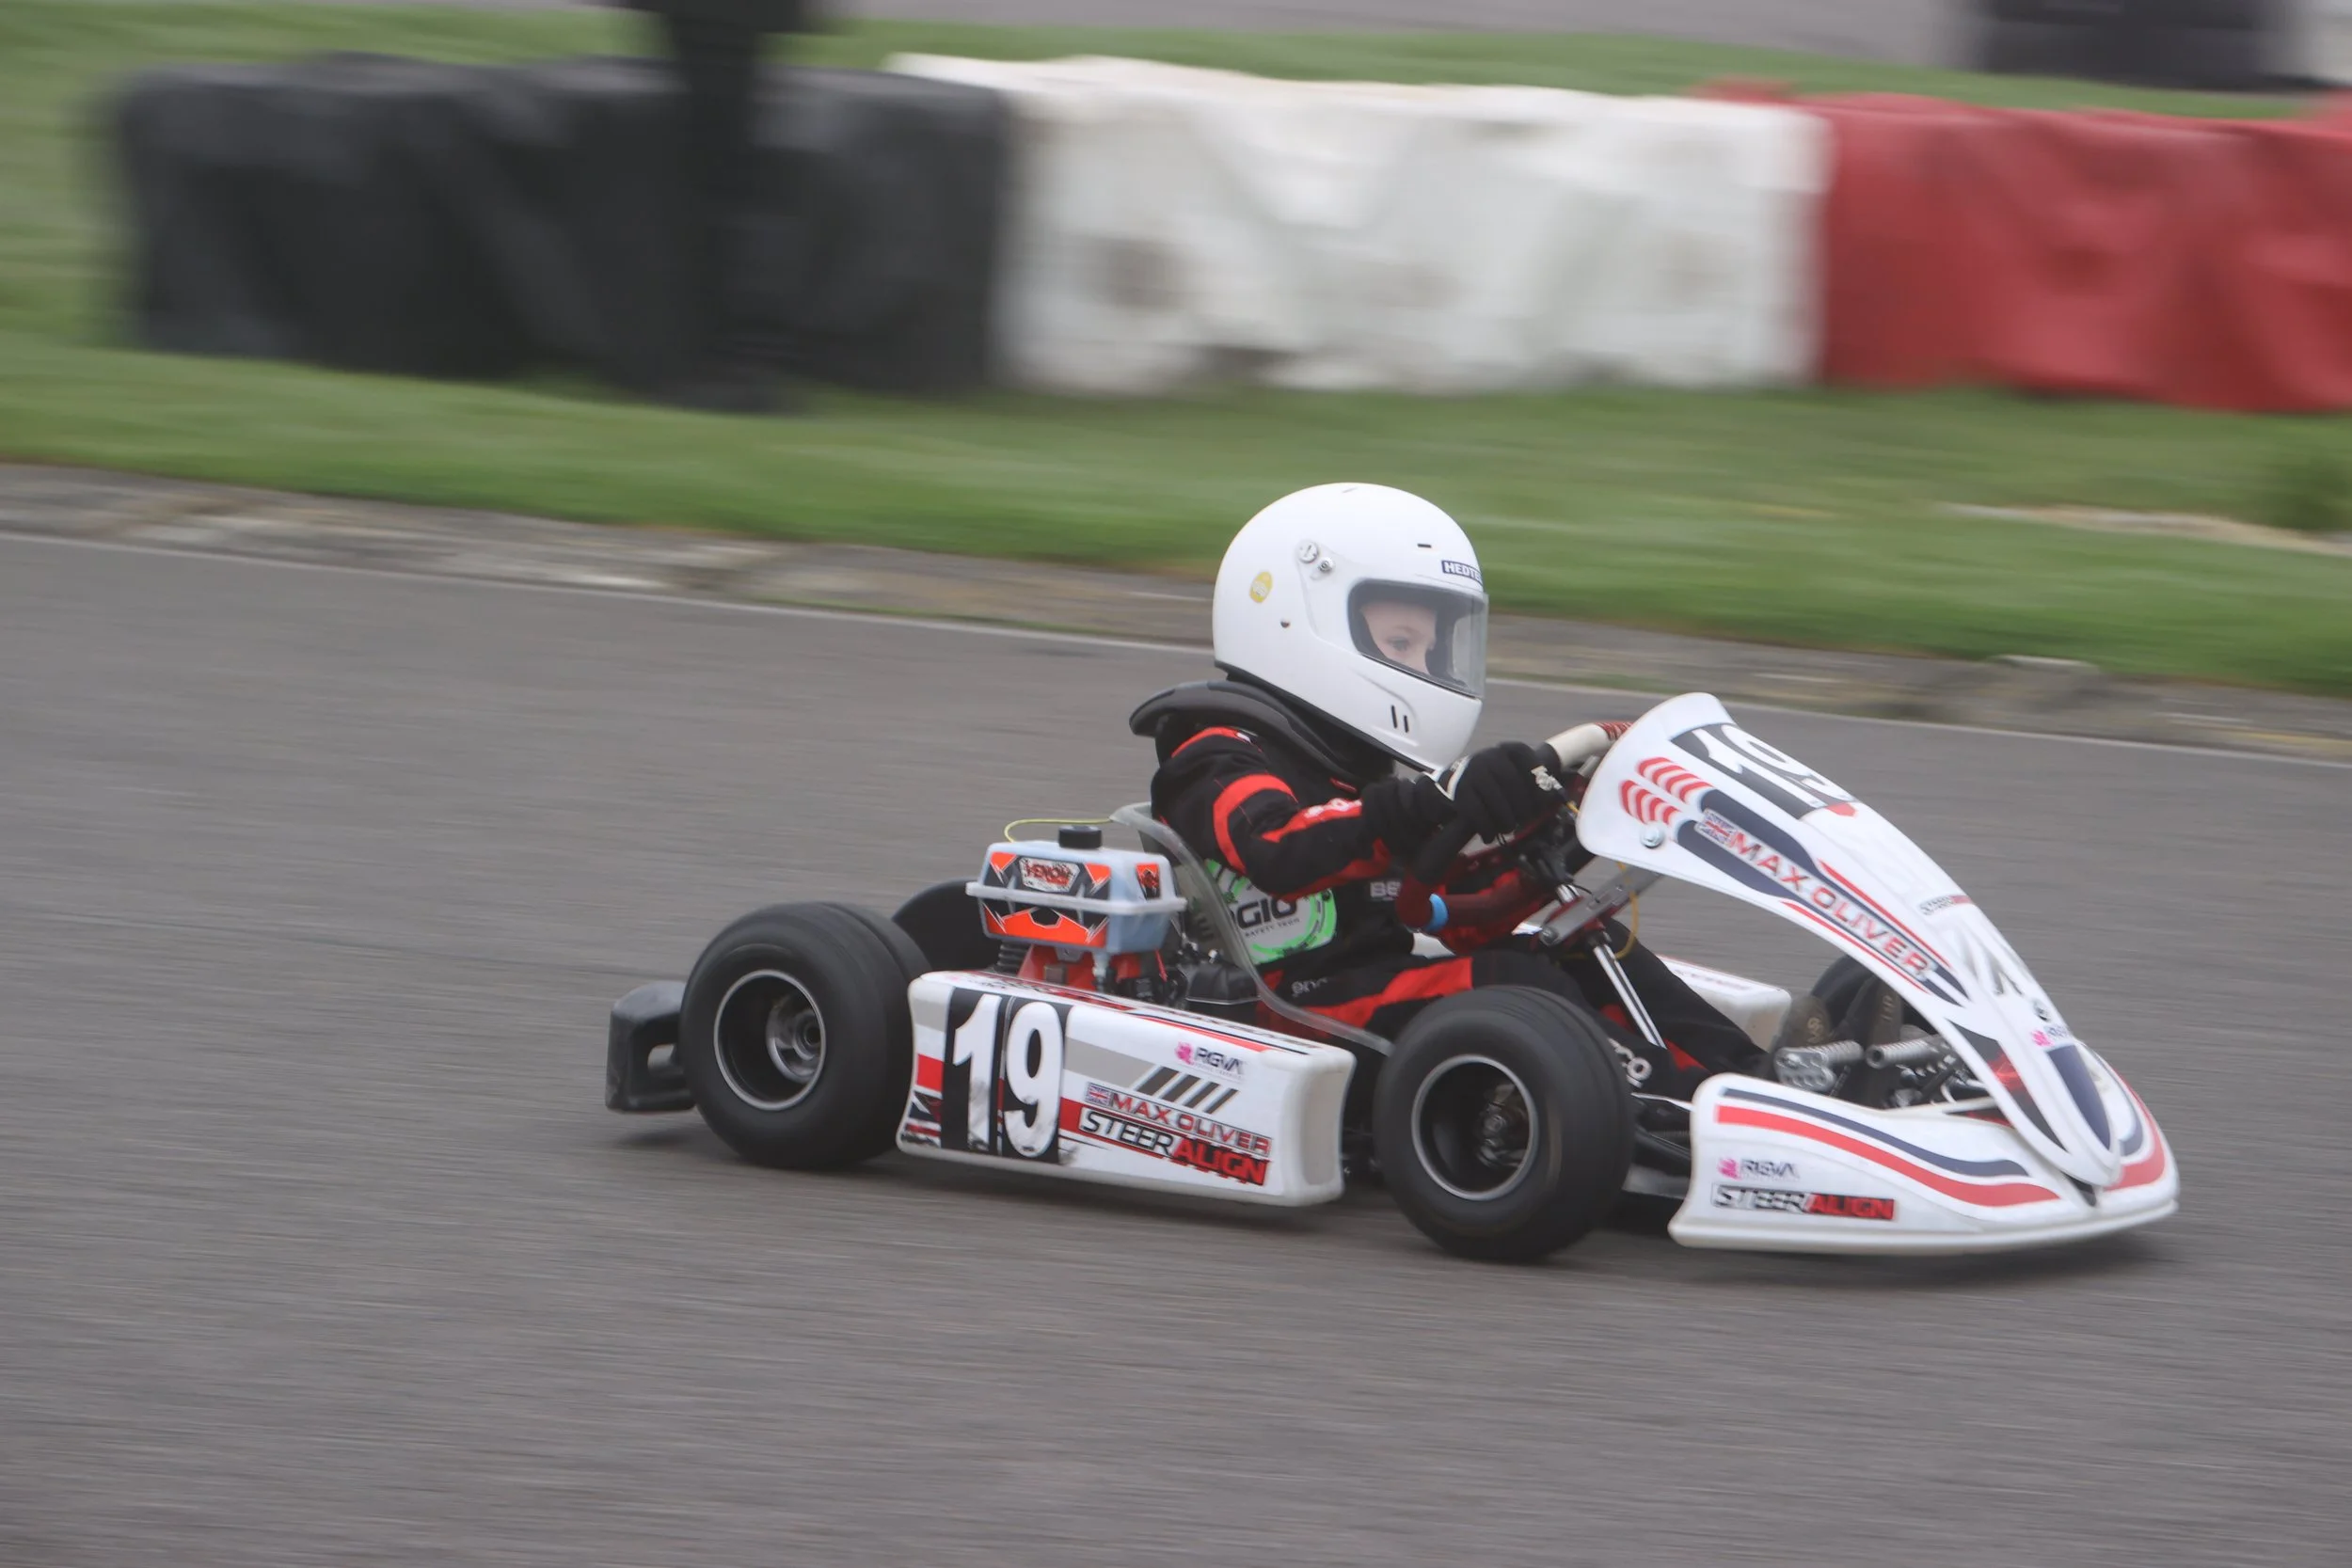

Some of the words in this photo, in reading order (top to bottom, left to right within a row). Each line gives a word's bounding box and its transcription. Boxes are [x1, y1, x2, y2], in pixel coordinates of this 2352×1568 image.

[1692, 724, 1856, 808] 19
[1230, 896, 1297, 929] GIO
[1725, 831, 1810, 892] MAX
[1811, 886, 1931, 980] OLIVER
[953, 993, 1064, 1158] 19
[1111, 1092, 1172, 1125] MAX
[1177, 1112, 1271, 1155] OLIVER
